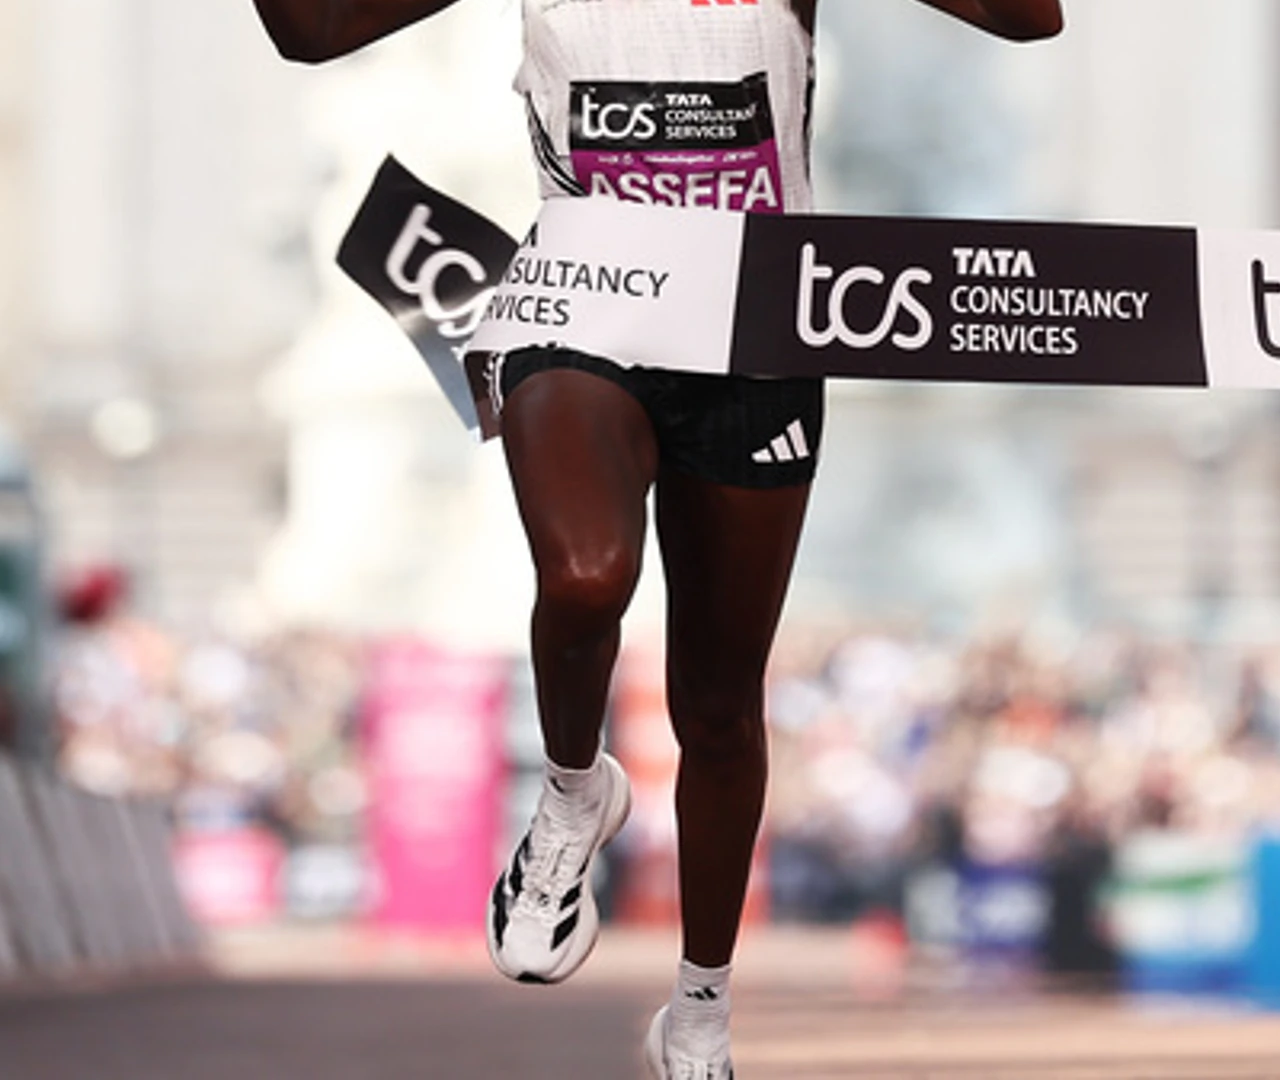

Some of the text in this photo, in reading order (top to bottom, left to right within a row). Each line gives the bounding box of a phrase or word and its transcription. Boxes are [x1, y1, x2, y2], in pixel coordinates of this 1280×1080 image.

[581, 92, 657, 140] tcs
[664, 93, 713, 107] TATA
[664, 125, 737, 140] SERVICES
[589, 167, 778, 212] ASSEFA
[504, 257, 668, 299] SULTANCY
[951, 247, 1036, 277] TATA
[796, 242, 933, 350] tcs
[950, 285, 1150, 319] CONSULTANCY
[950, 324, 1079, 354] SERVICES
